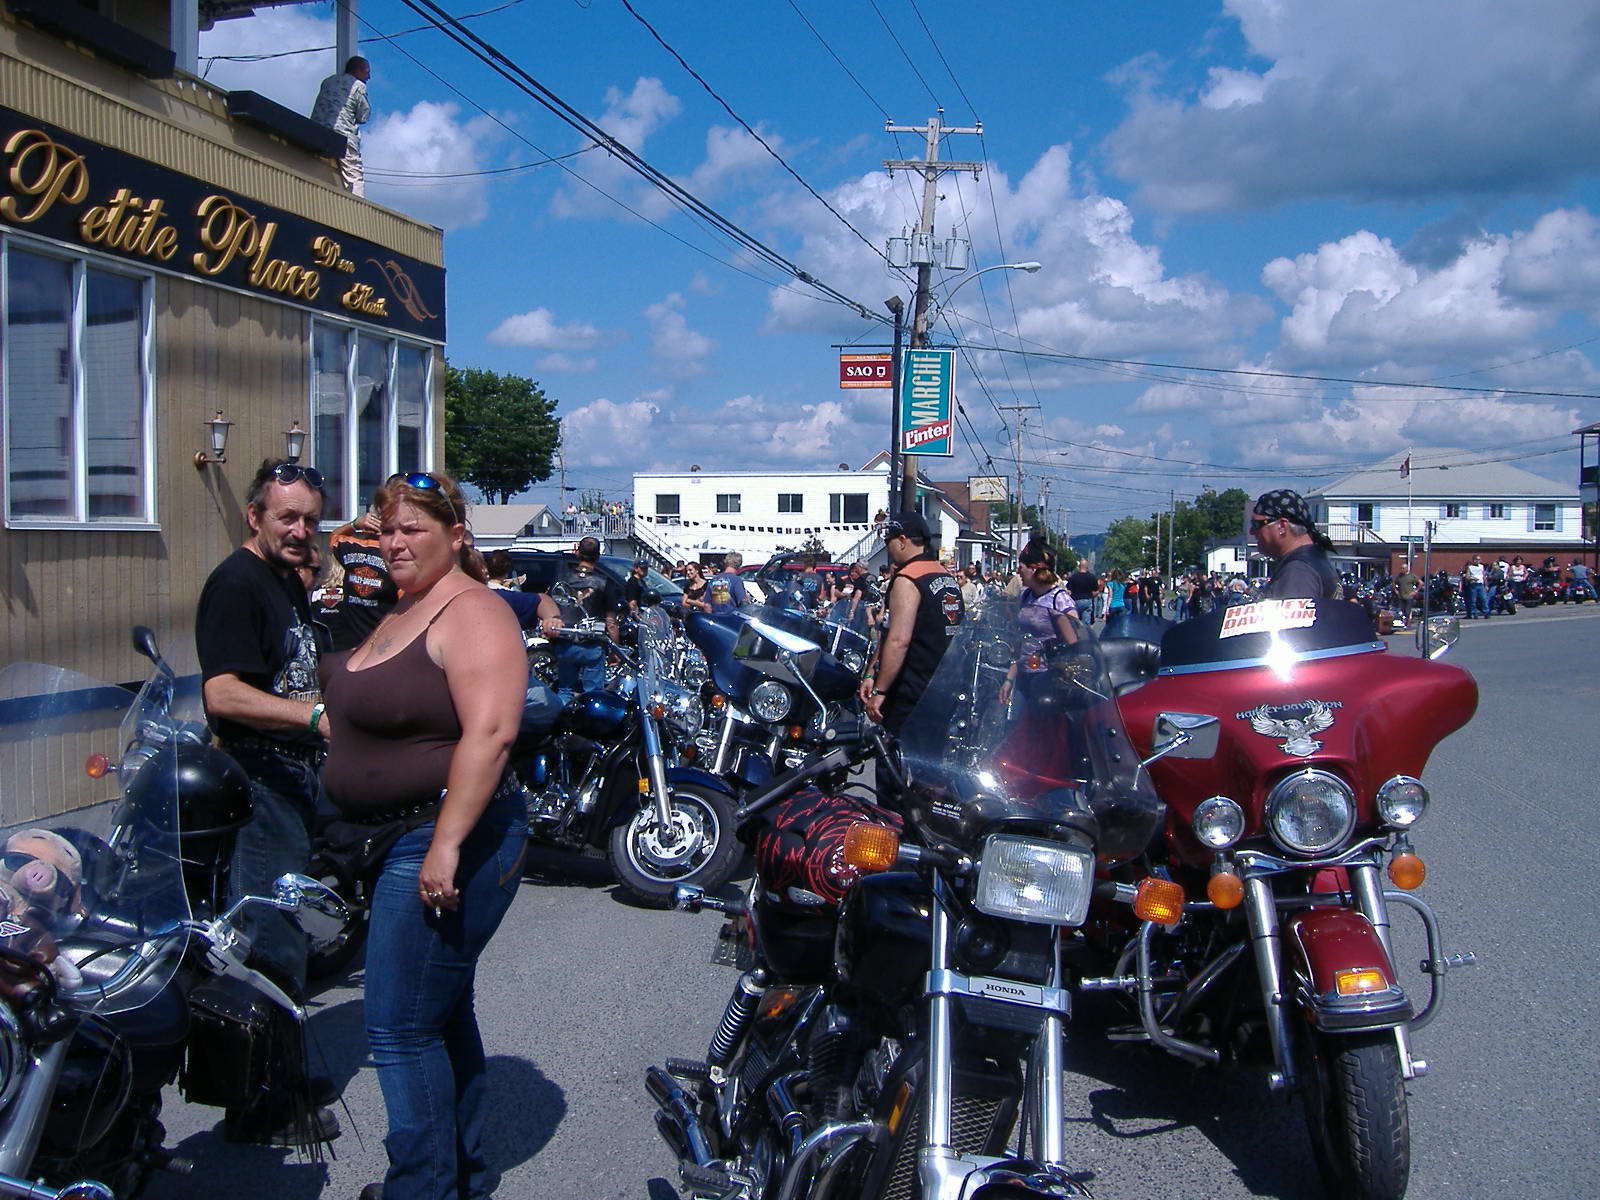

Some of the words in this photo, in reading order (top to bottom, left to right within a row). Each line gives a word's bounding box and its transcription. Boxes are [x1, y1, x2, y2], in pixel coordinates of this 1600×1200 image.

[0, 129, 179, 260] Petite
[193, 195, 321, 300] Place
[313, 236, 356, 273] D'en
[846, 366, 873, 377] SAQ
[905, 423, 950, 449] L'inter
[985, 983, 1026, 996] HONDA
